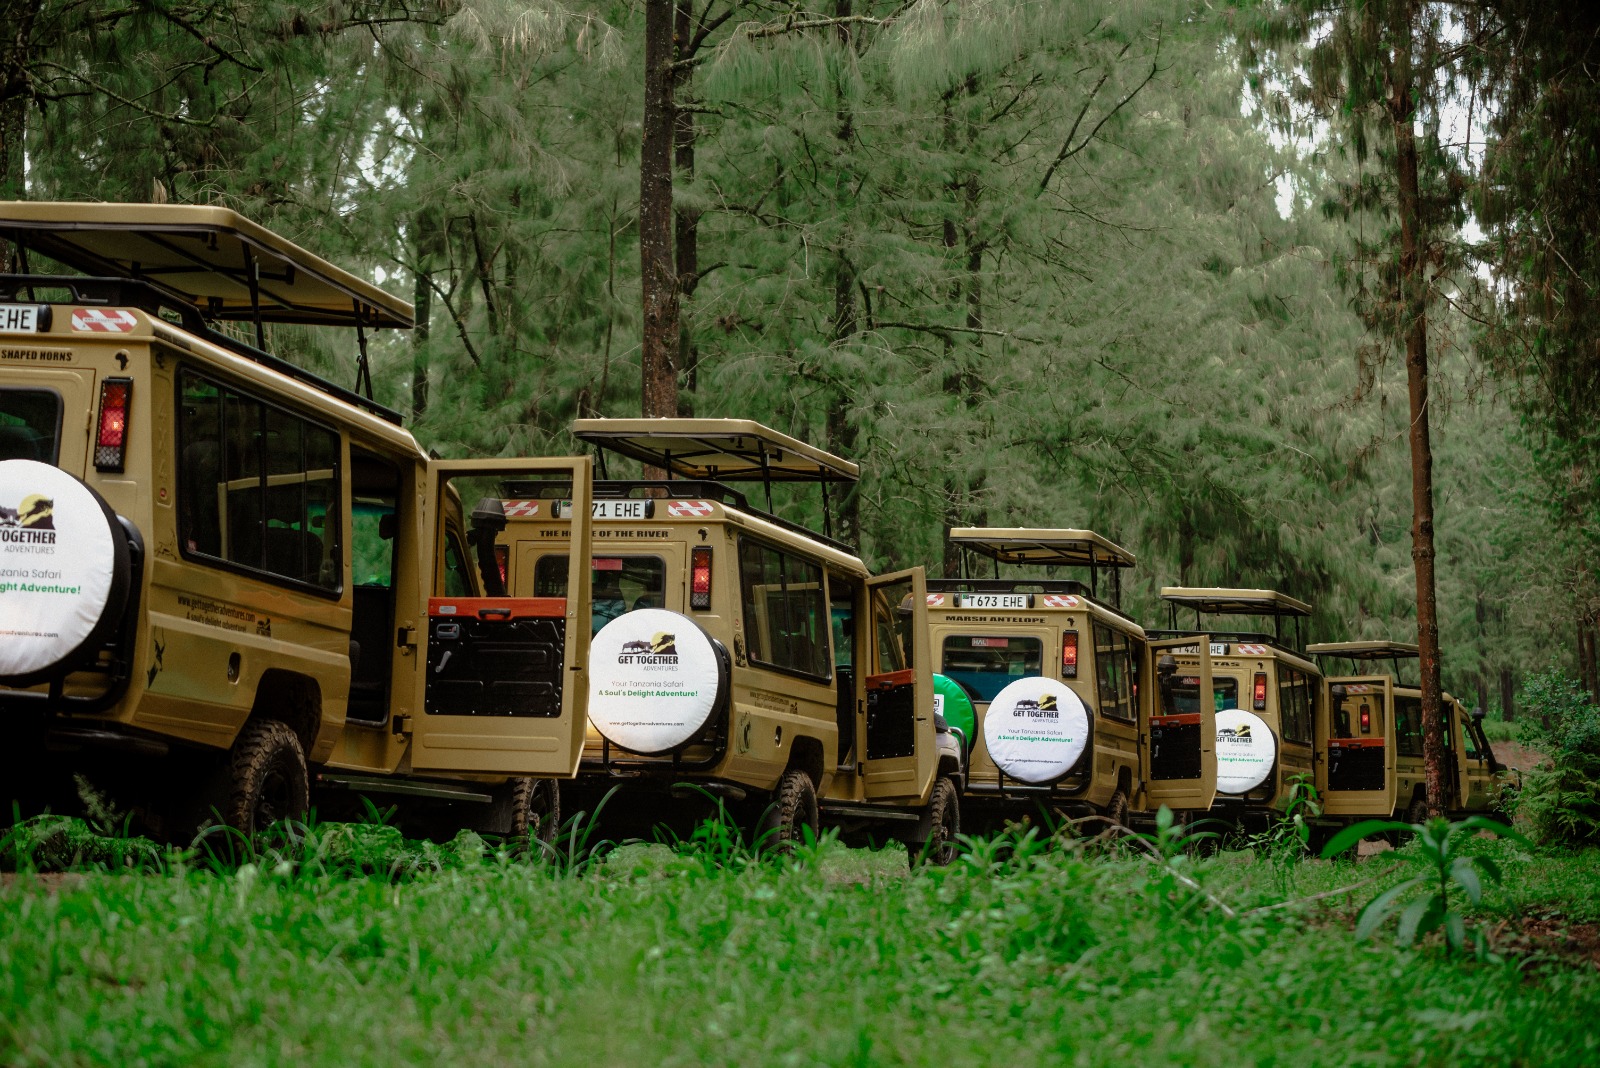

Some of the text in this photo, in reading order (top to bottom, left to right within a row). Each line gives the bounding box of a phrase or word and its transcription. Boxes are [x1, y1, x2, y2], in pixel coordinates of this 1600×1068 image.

[1, 350, 72, 362] SHAPED HORNS
[615, 503, 640, 517] EHE
[0, 529, 56, 544] OGETHER
[4, 545, 55, 555] ADVENTURES
[32, 568, 61, 579] Safari
[20, 582, 81, 594] Adventure!
[969, 596, 1023, 607] T 673 EHE
[618, 655, 678, 665] GET TOGETHER
[662, 680, 684, 688] Safari
[627, 689, 655, 698] Delight
[655, 690, 698, 698] Adventure!
[1013, 710, 1059, 719] GET TOGETHER
